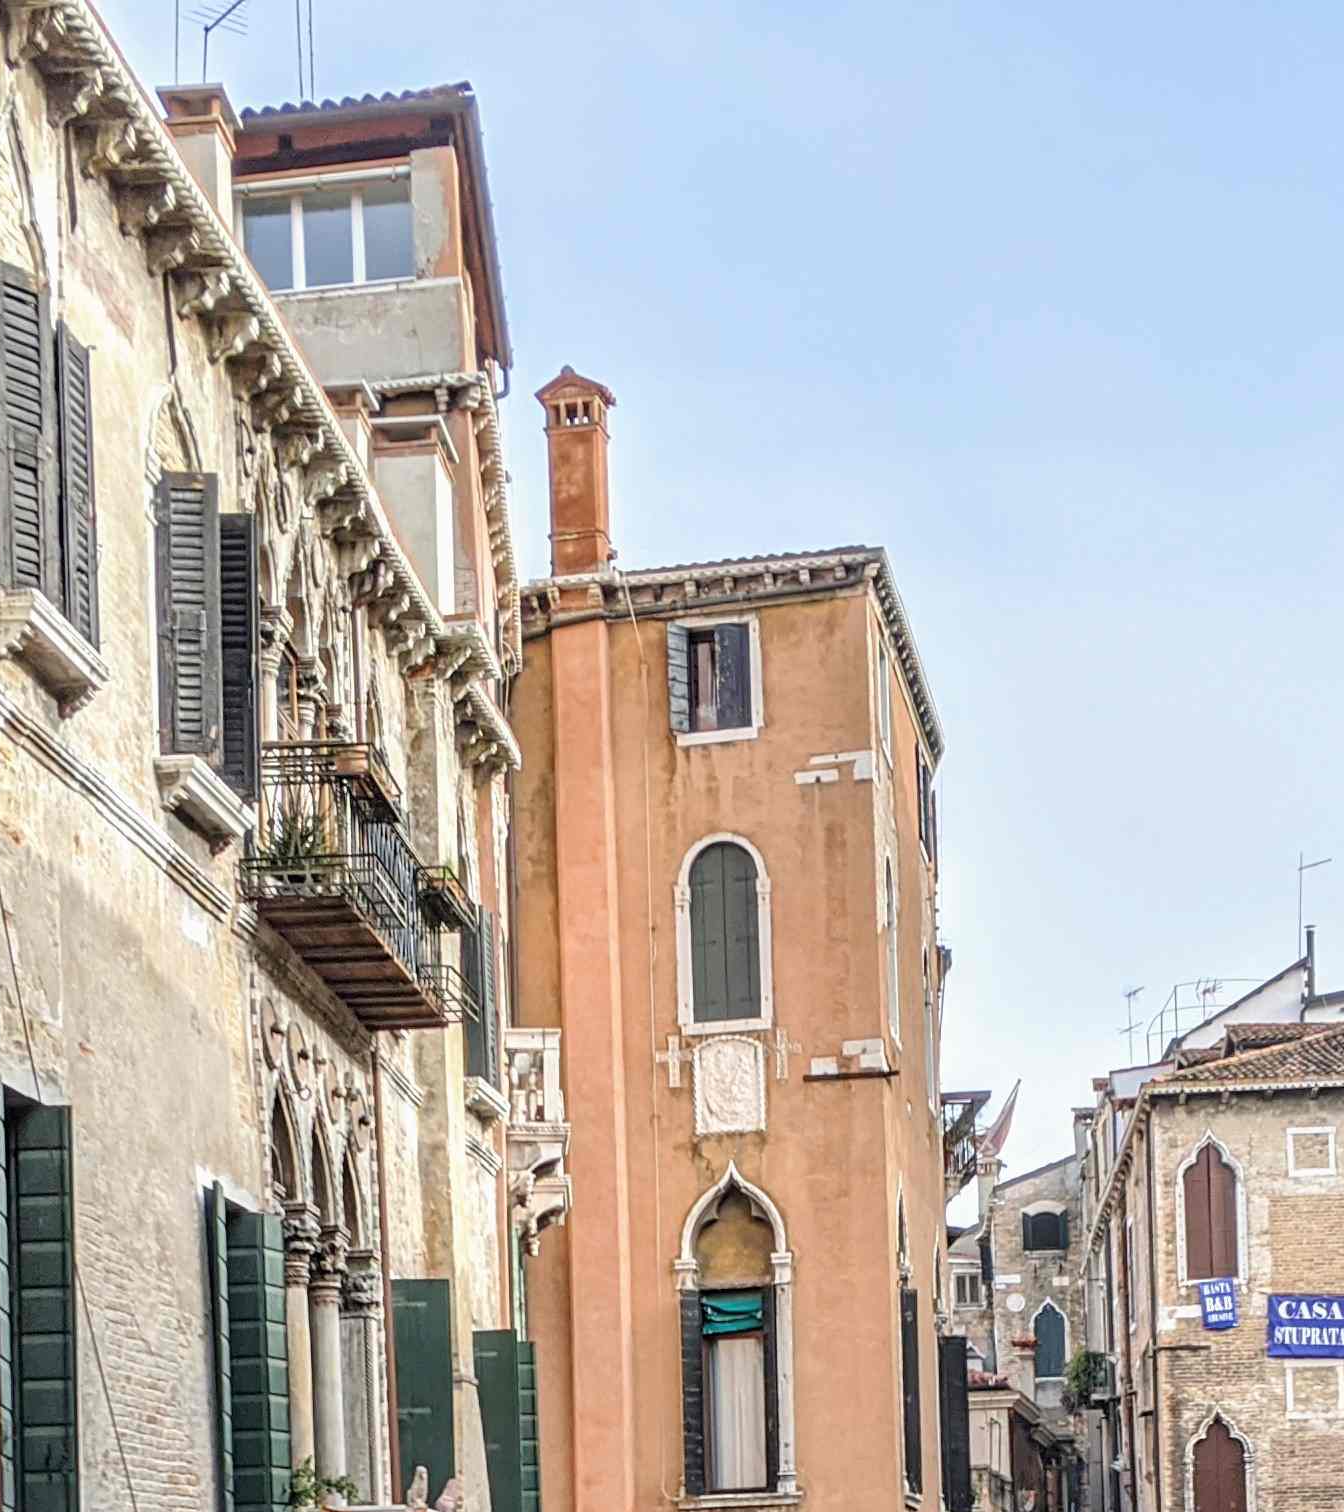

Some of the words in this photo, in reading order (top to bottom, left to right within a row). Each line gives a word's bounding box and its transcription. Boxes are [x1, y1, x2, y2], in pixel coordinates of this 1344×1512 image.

[1203, 1281, 1231, 1296] BASTA
[1205, 1296, 1233, 1312] B&B
[1278, 1300, 1344, 1321] CASA
